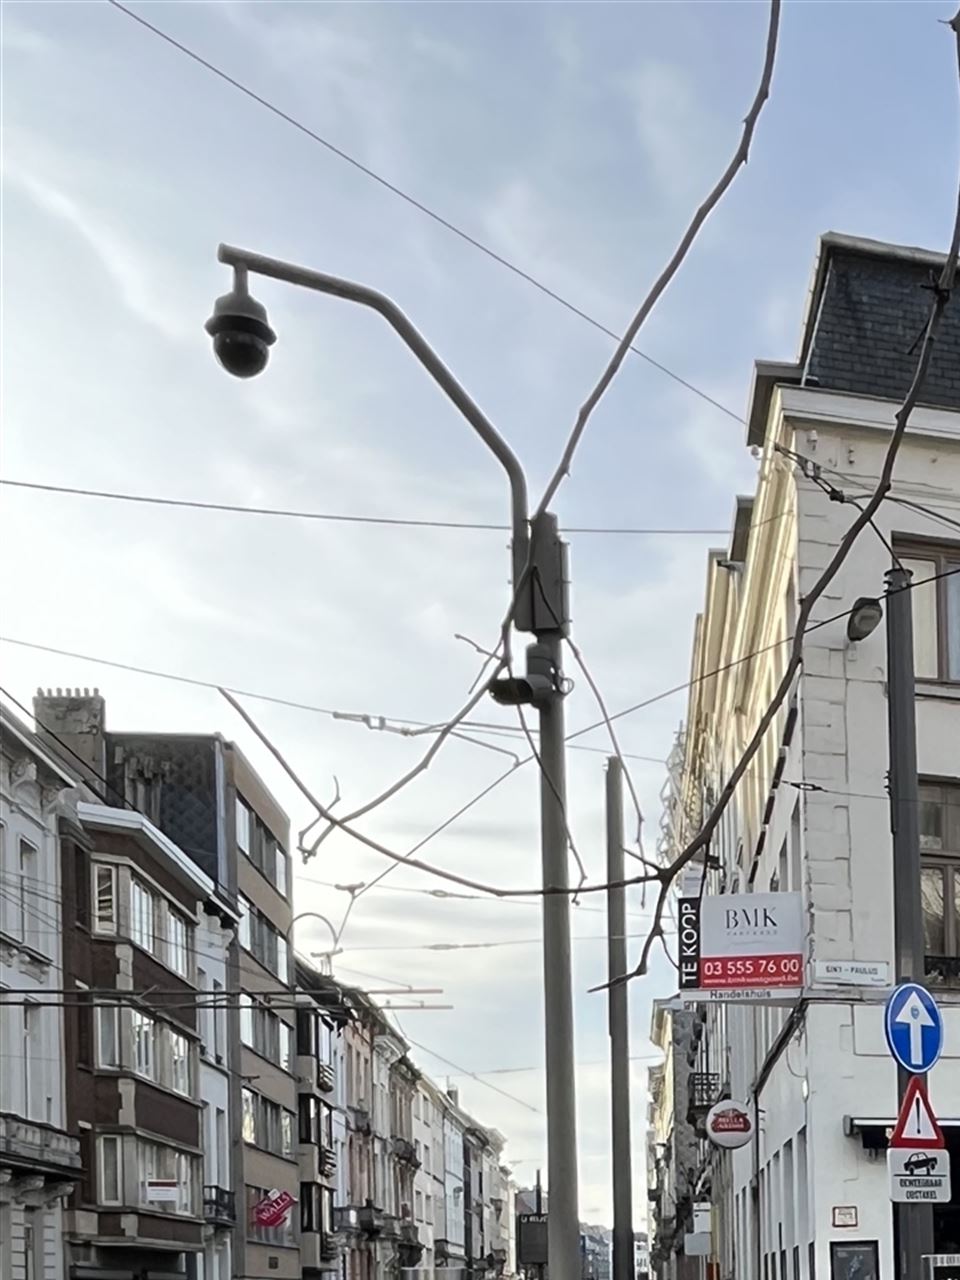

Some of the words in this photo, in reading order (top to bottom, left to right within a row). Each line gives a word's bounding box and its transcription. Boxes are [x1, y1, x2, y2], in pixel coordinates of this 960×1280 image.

[725, 906, 777, 929] BMK
[682, 903, 698, 956] KOOP
[682, 961, 698, 984] TE
[704, 962, 722, 976] 03
[727, 960, 754, 975] 555
[758, 960, 777, 974] 76
[780, 959, 799, 972] 00
